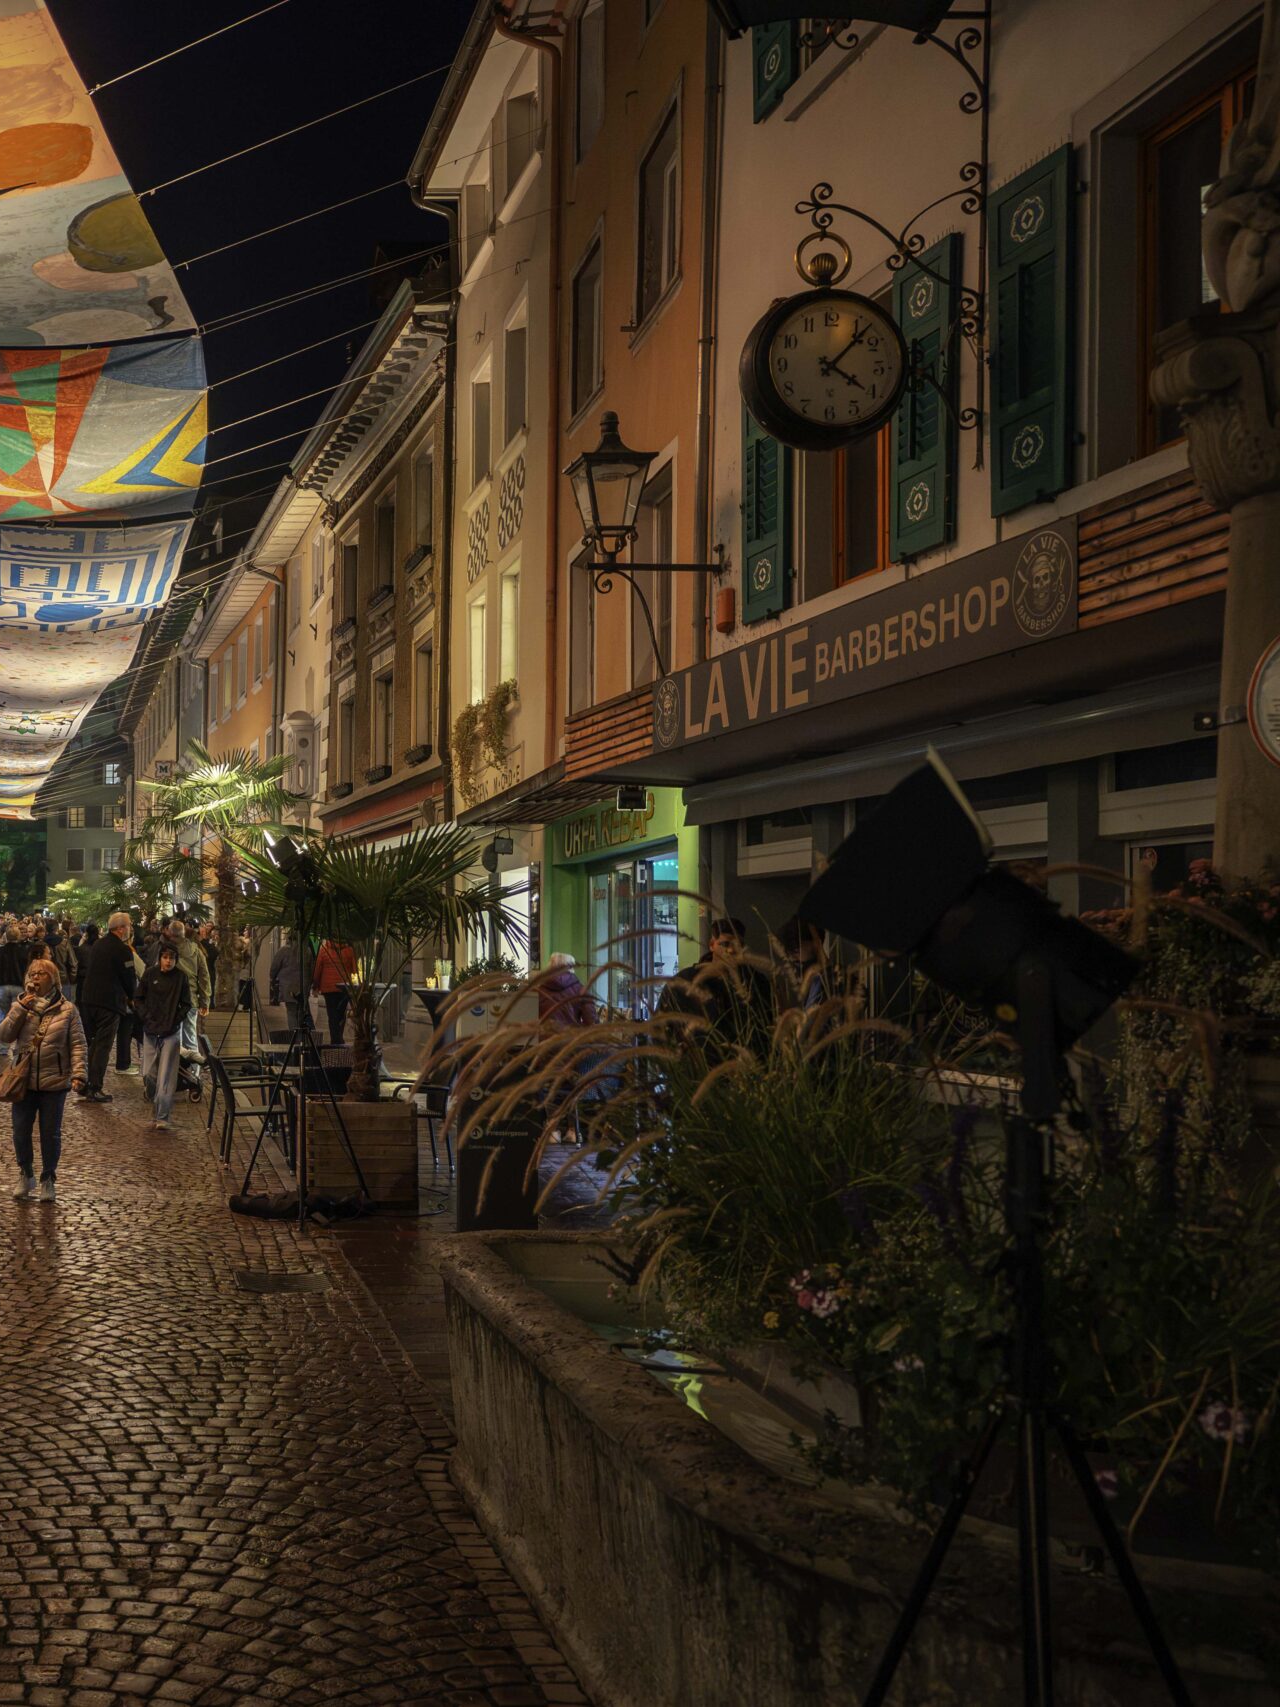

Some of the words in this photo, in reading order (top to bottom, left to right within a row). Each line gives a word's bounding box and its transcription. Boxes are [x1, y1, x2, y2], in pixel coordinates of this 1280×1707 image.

[803, 317, 814, 332] 11
[824, 311, 839, 327] 12
[784, 334, 798, 349] 10
[867, 336, 879, 352] 2
[777, 357, 787, 372] 9
[783, 381, 794, 396] 8
[865, 383, 876, 399] 4
[800, 398, 811, 414] 7
[824, 405, 835, 420] 6
[848, 400, 859, 415] 5
[1022, 543, 1038, 564] LA
[1040, 536, 1060, 553] VIE
[1017, 593, 1066, 631] BARBERSHOP
[685, 660, 730, 740] LA
[739, 626, 809, 721] VIE
[815, 576, 1010, 683] BARBERSHOP
[159, 765, 169, 774] M
